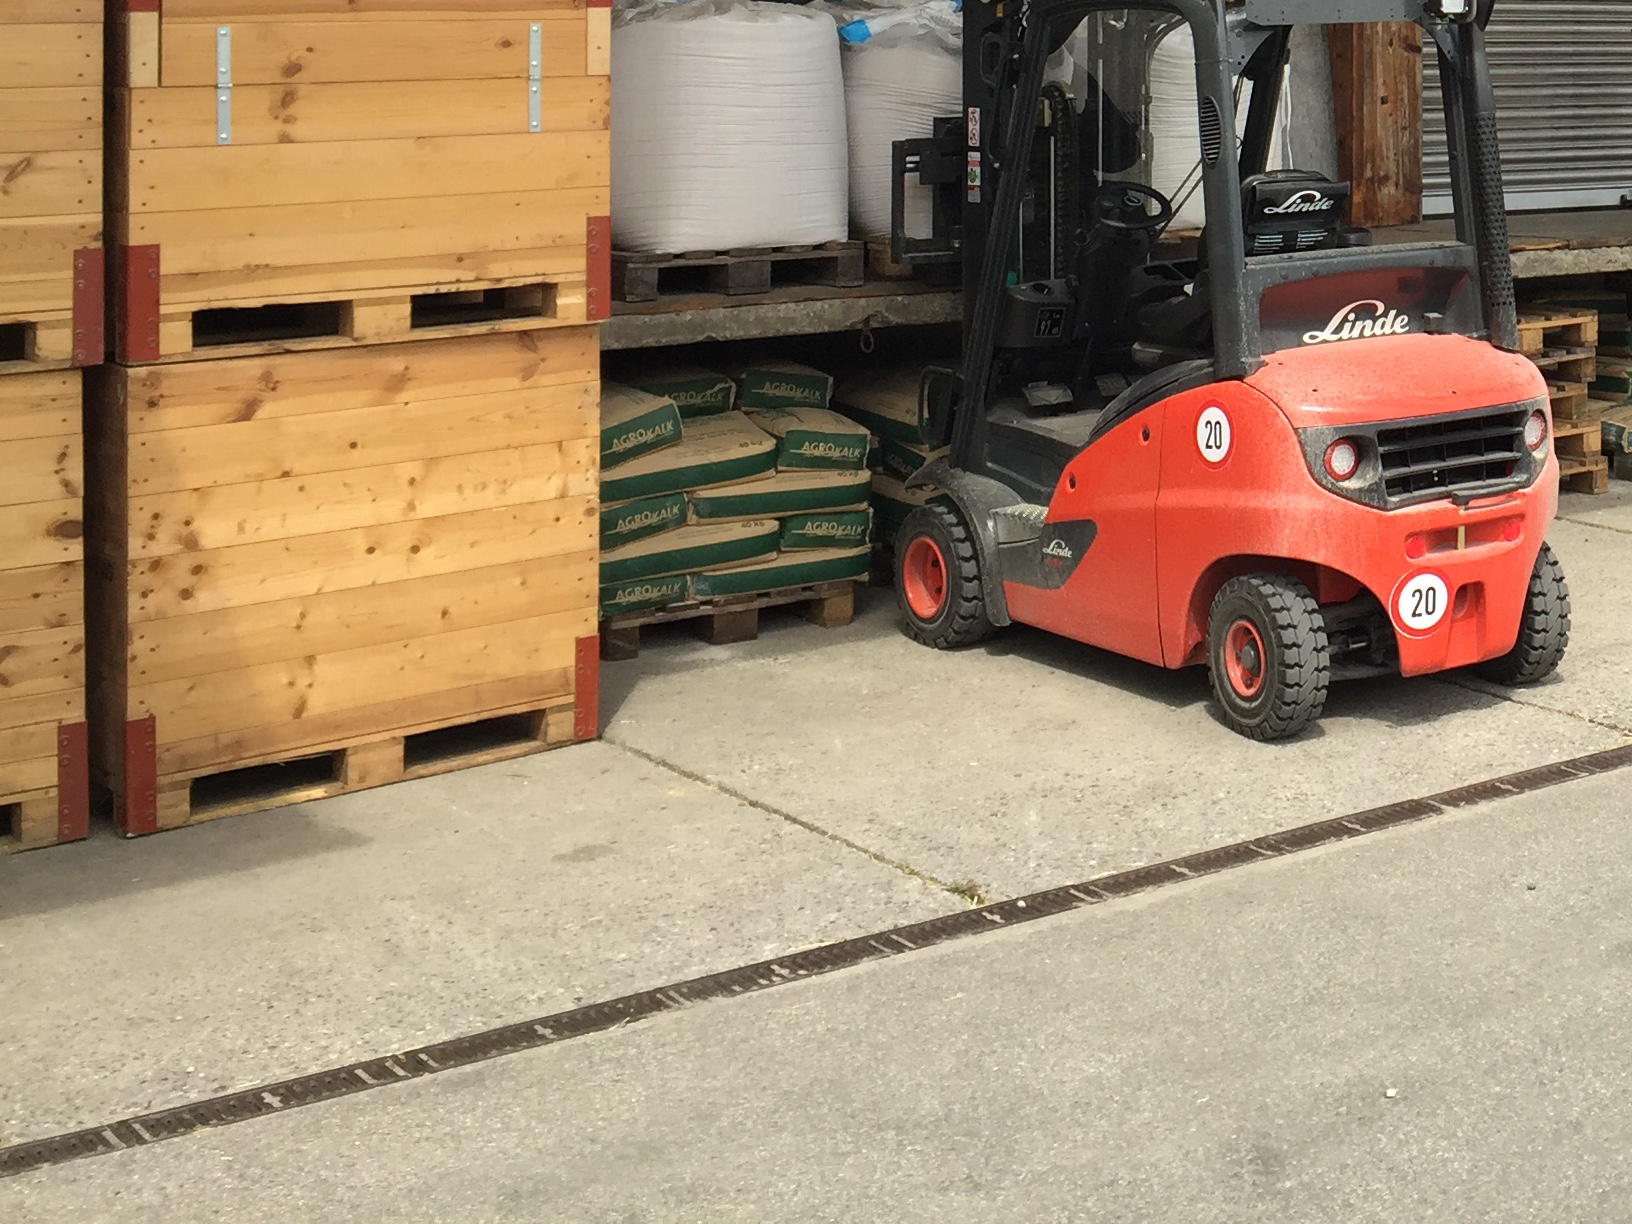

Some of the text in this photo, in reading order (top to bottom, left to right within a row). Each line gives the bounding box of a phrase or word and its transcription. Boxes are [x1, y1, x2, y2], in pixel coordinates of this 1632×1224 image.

[1263, 190, 1334, 214] Linde
[1302, 299, 1410, 344] Linde
[763, 381, 822, 400] AGROKALK
[612, 419, 675, 450] AGROKALK
[1205, 420, 1222, 450] 20
[801, 441, 862, 458] AGROKALK
[615, 504, 680, 531] AGROKALK
[804, 521, 865, 536] AGROKALK
[1042, 539, 1073, 558] Linde
[615, 582, 682, 602] AGROKALK
[1411, 586, 1436, 618] 20
